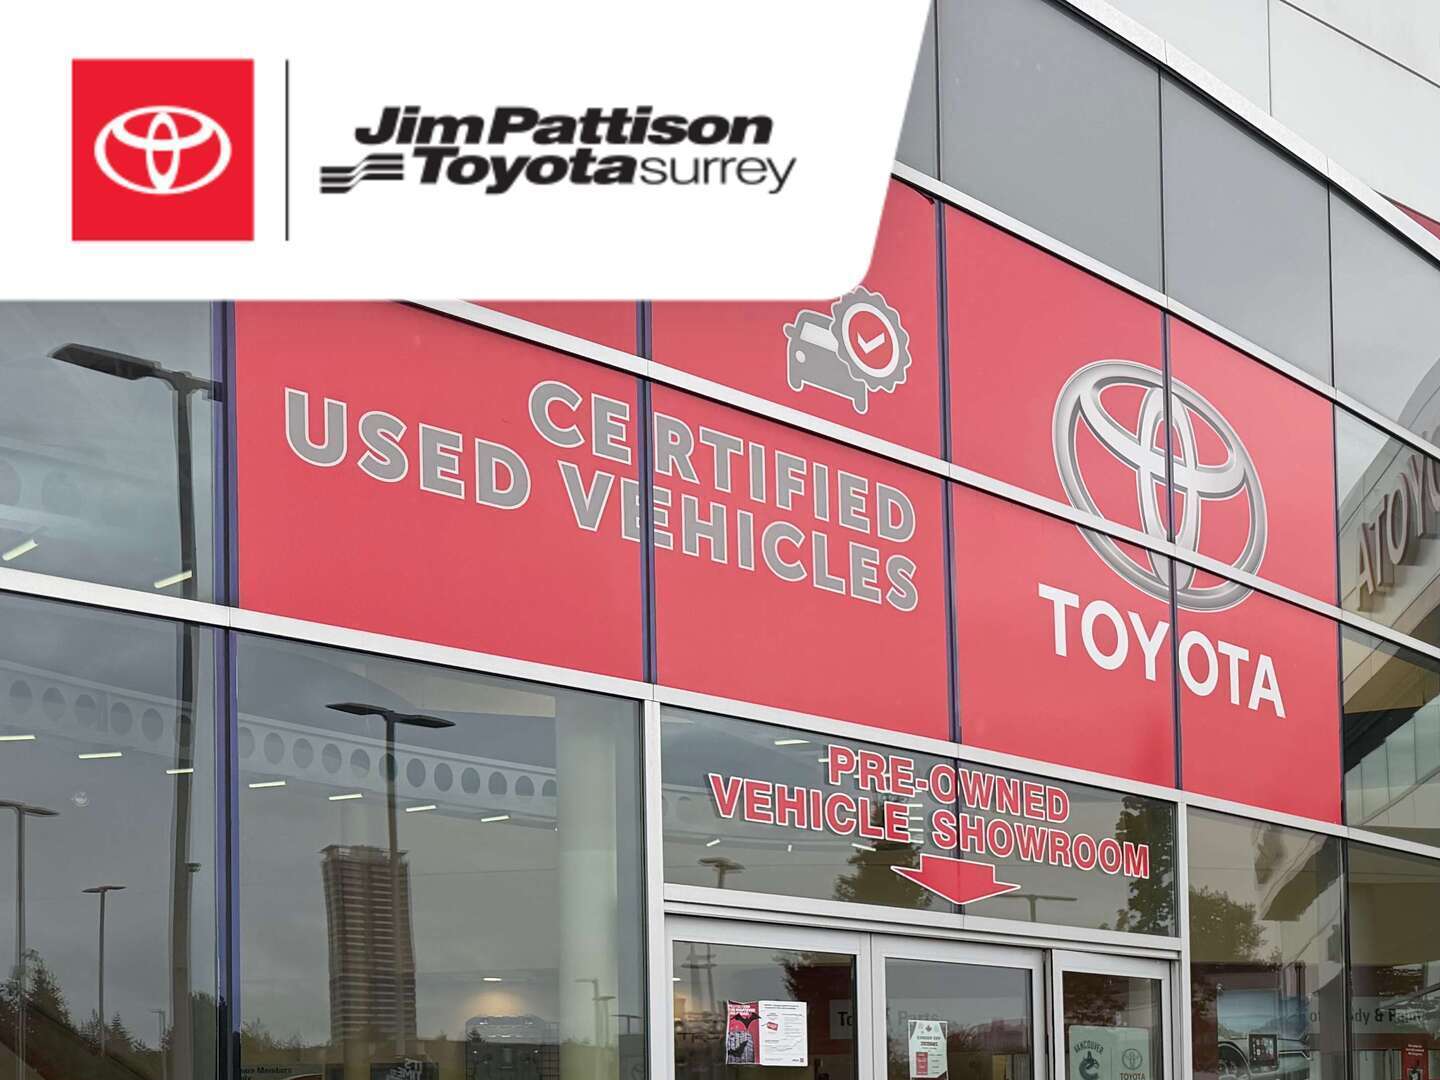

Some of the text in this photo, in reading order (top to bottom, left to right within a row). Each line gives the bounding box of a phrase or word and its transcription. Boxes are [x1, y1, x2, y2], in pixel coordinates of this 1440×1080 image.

[284, 385, 920, 613] USED VEHICLES
[528, 378, 917, 544] CERTIFIED
[1037, 582, 1287, 719] TOYOTA
[708, 772, 1150, 880] VEHICLE SHOWROOM
[827, 743, 1070, 824] PRE-OWNED
[1120, 1072, 1145, 1080] TOYOTA
